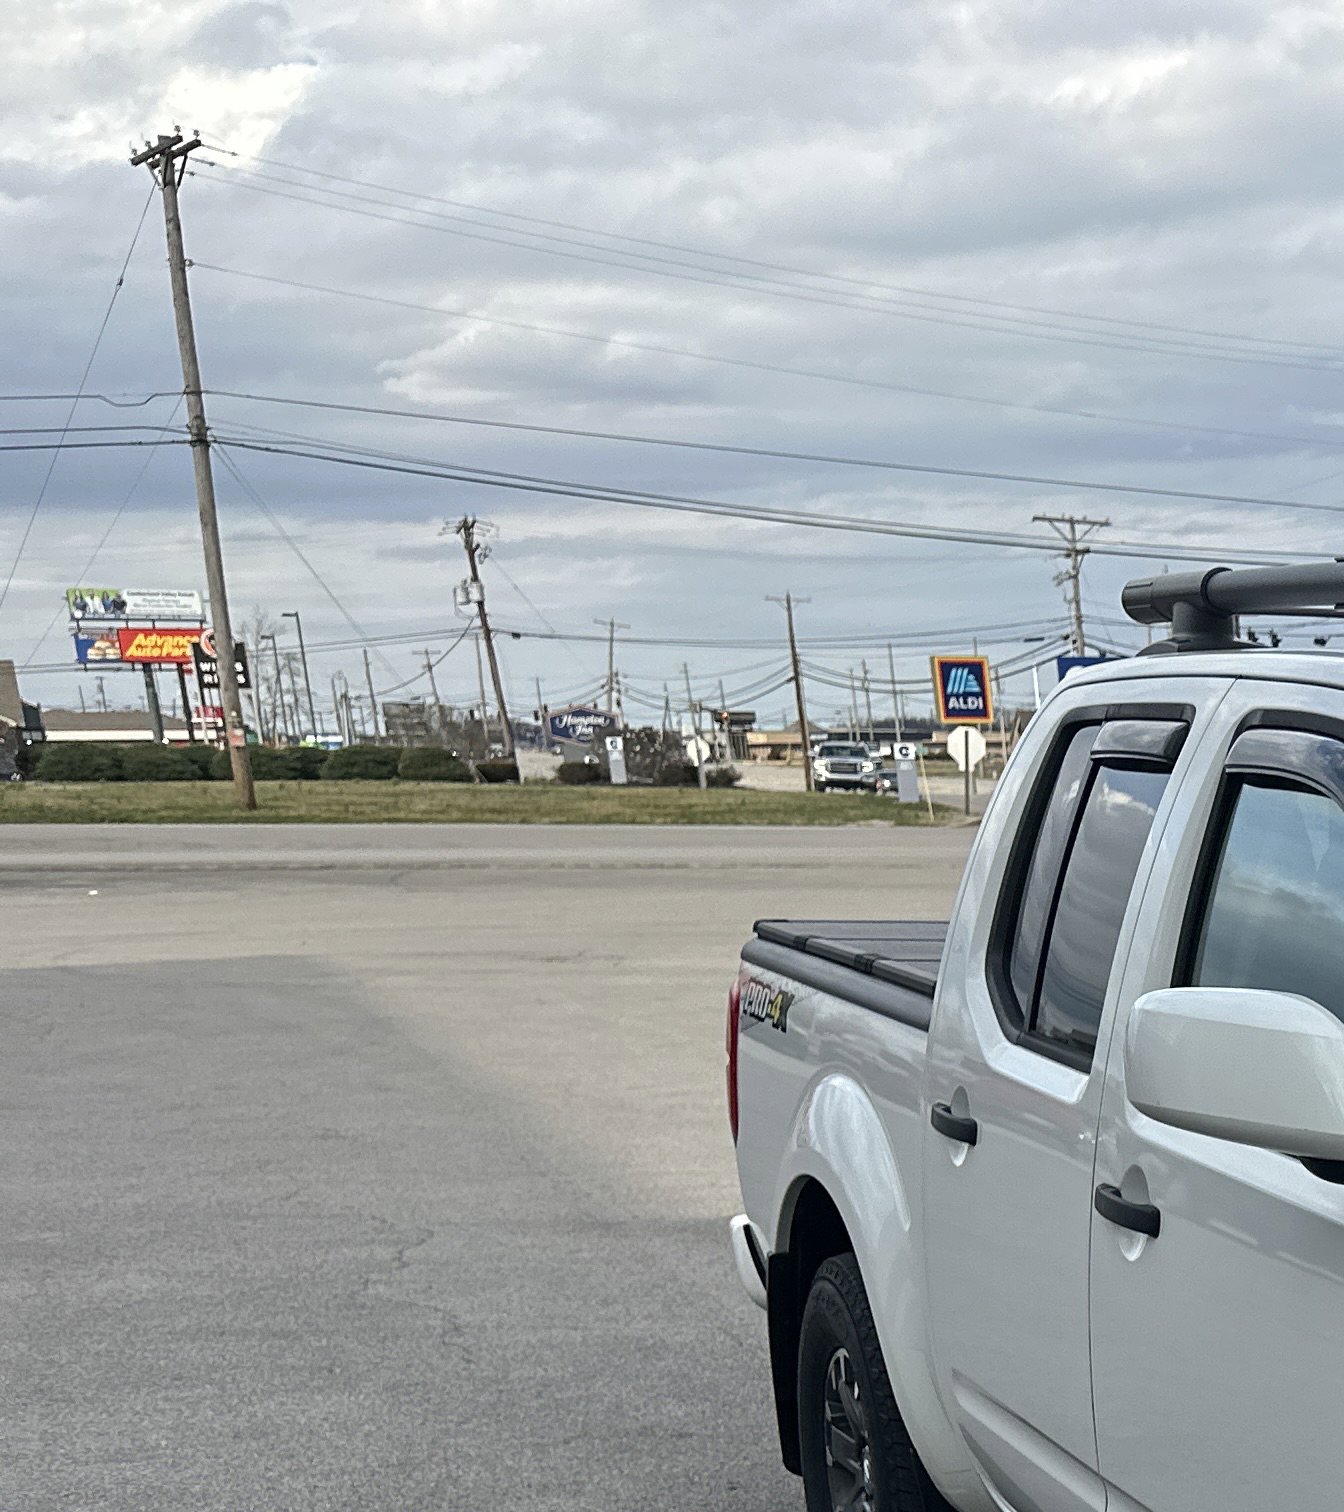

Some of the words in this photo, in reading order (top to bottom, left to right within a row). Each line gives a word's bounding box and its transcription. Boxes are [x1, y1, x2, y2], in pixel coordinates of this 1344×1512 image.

[125, 642, 161, 657] Auto
[161, 642, 193, 657] Part
[200, 662, 244, 672] WIS
[948, 696, 984, 710] ALDI
